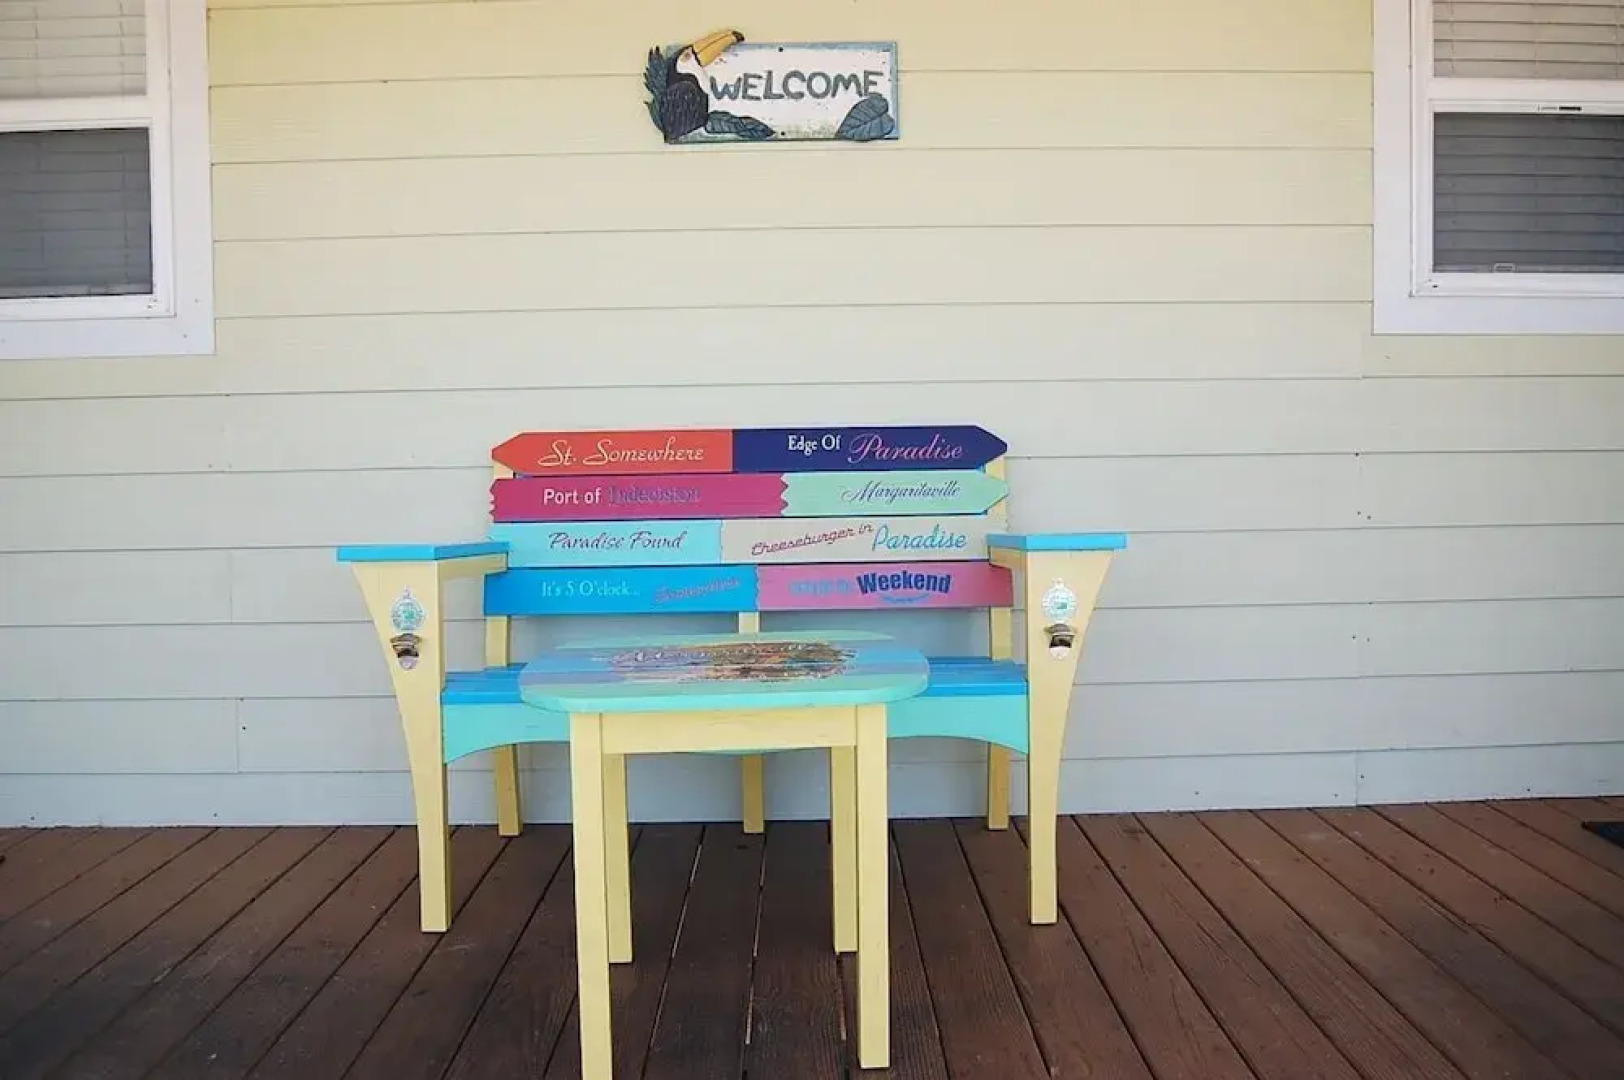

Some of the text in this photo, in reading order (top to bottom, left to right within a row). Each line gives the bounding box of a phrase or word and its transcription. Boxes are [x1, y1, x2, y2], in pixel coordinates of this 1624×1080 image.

[709, 69, 884, 101] WELCOME
[537, 436, 704, 466] St. Somewhere
[788, 431, 963, 464] Edge Of Paradise
[543, 488, 579, 505] Port
[584, 487, 602, 505] of
[840, 480, 960, 504] Margaritaville
[549, 530, 688, 550] Paradise Found
[751, 522, 967, 556] Cheeseburger in Paradise
[541, 581, 561, 597] It's
[565, 580, 575, 597] 5
[856, 569, 953, 594] Weekend
